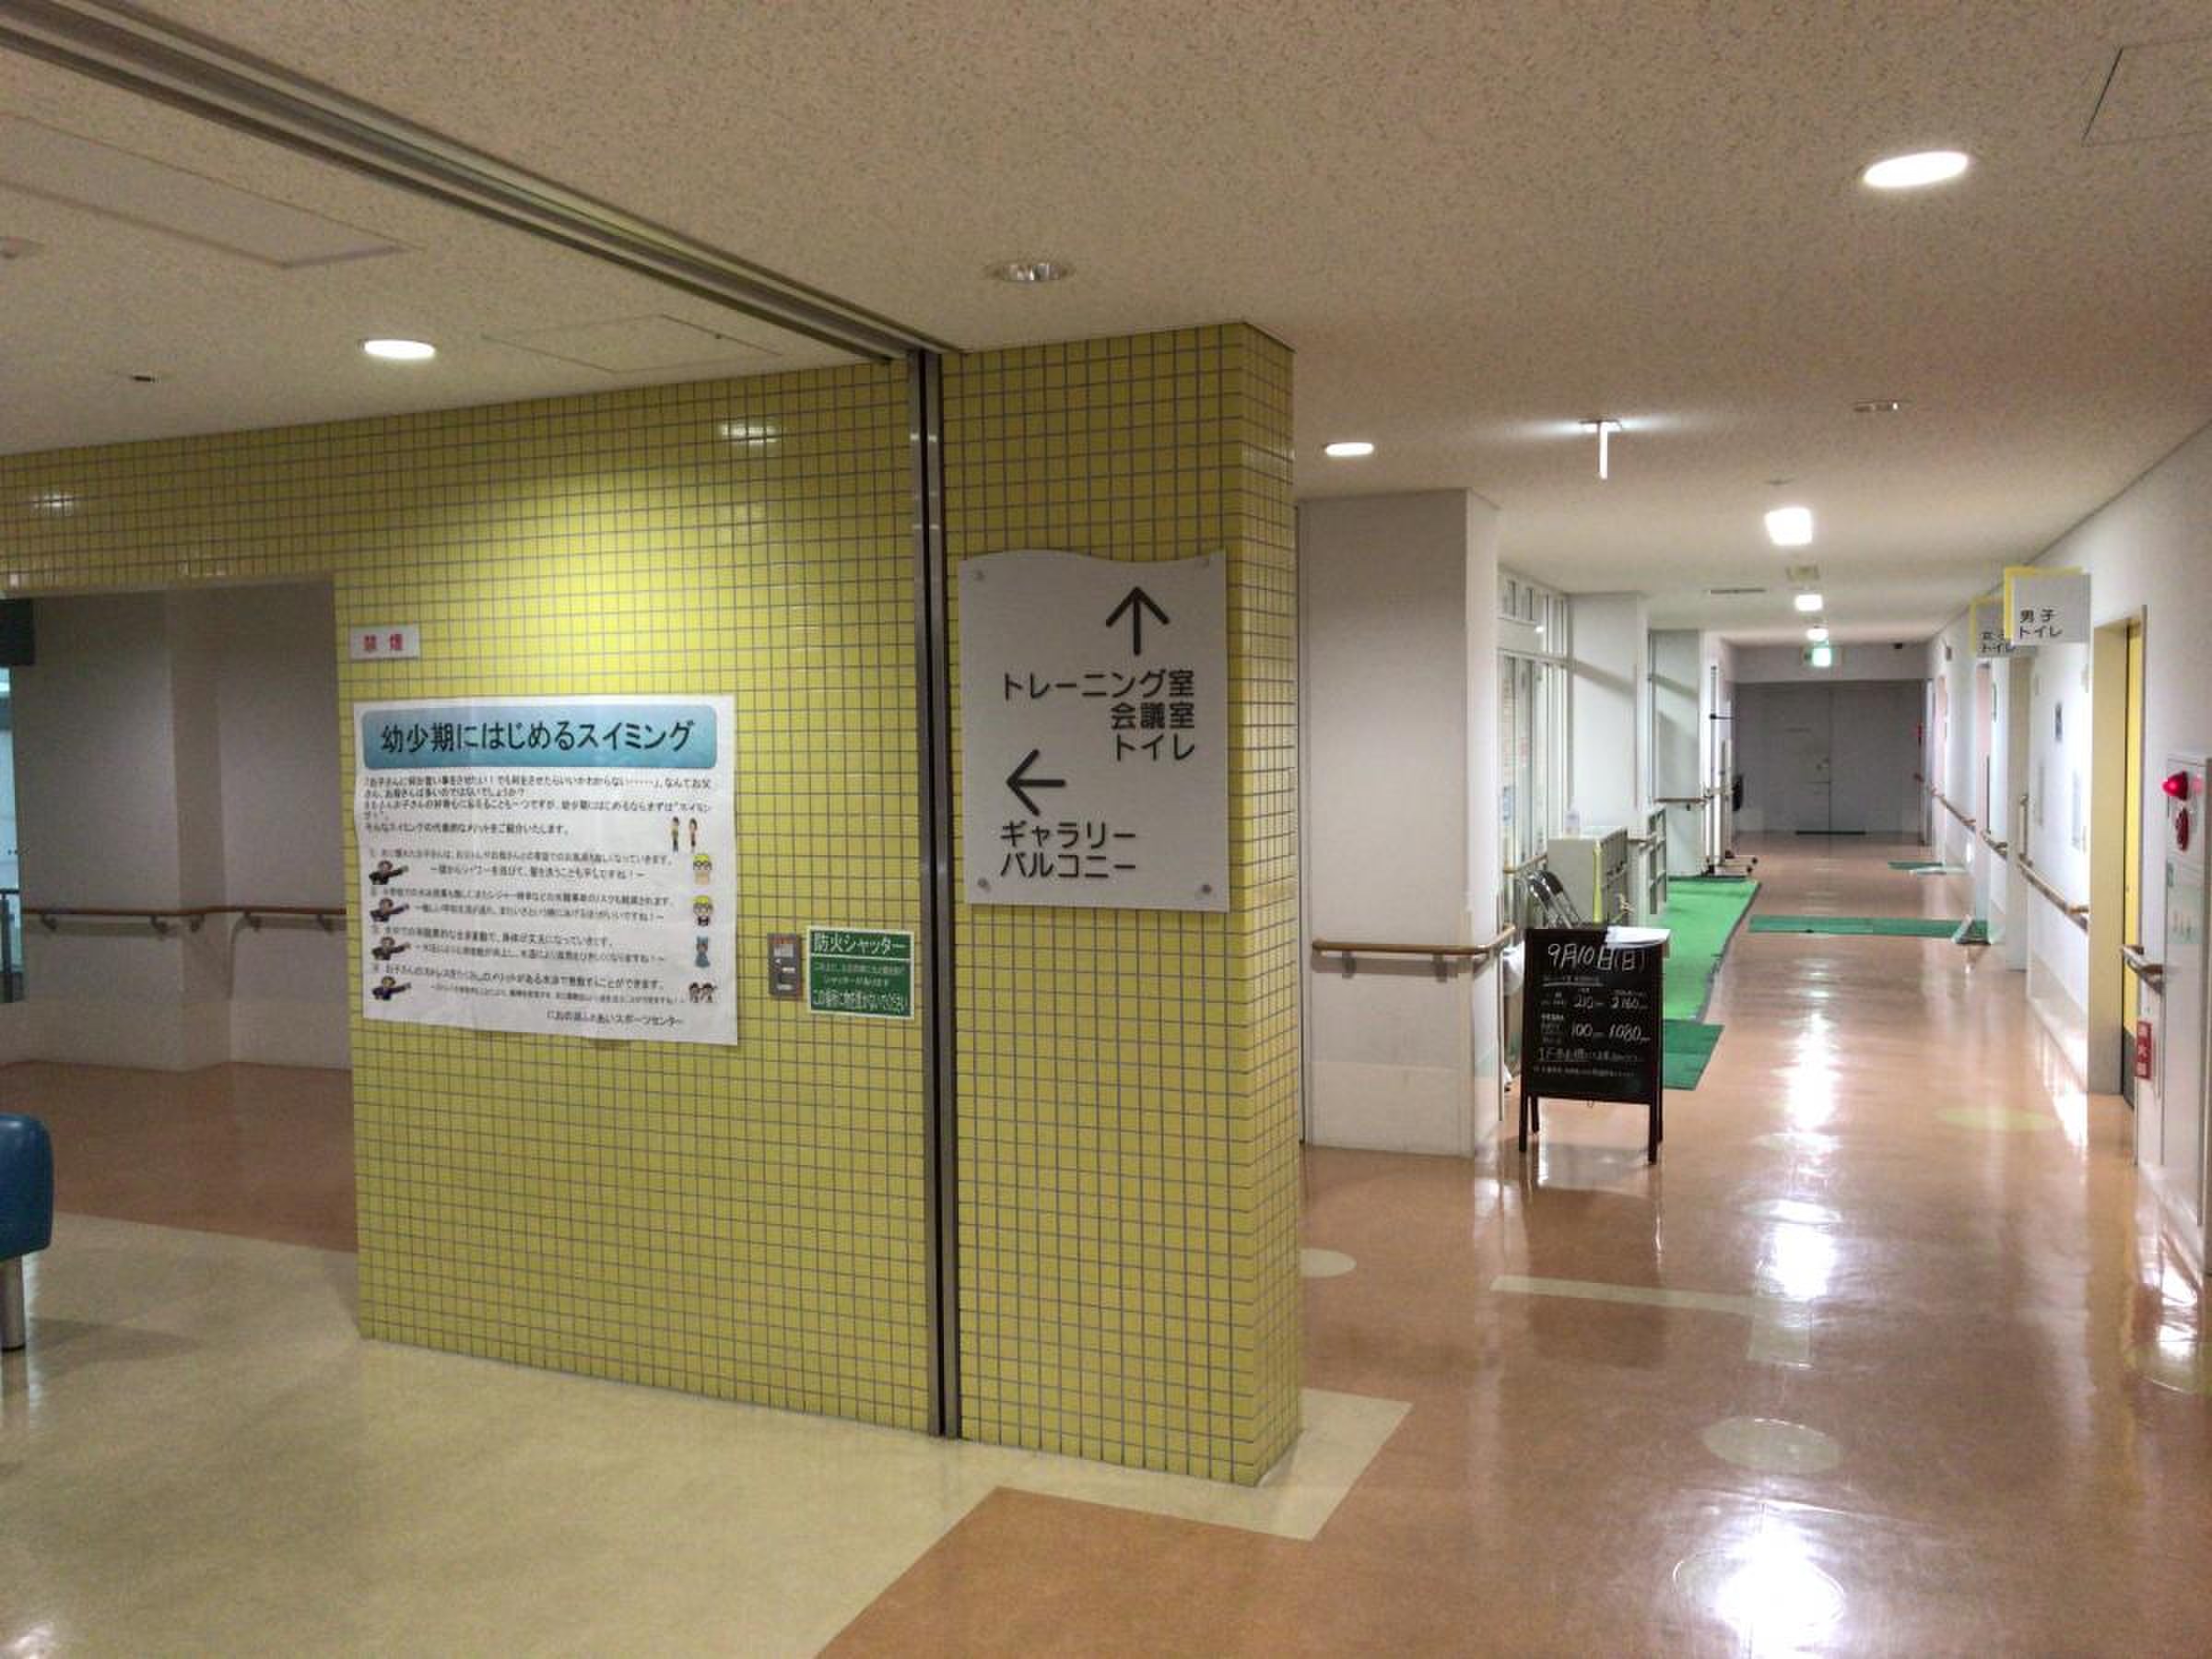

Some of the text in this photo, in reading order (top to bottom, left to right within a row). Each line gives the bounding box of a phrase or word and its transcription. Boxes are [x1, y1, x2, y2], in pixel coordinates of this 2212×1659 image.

[2018, 609, 2056, 622] 男子
[2019, 626, 2063, 640] トイレ
[1005, 669, 1194, 700] トレーニング室
[1111, 702, 1195, 730] 会議室
[381, 720, 695, 753] 幼少期にはじめるスイミング
[1116, 735, 1195, 761] トイレ
[1001, 820, 1135, 849] ギャラリー
[1000, 852, 1135, 879] バルコニー
[814, 932, 907, 955] 防火シャッター
